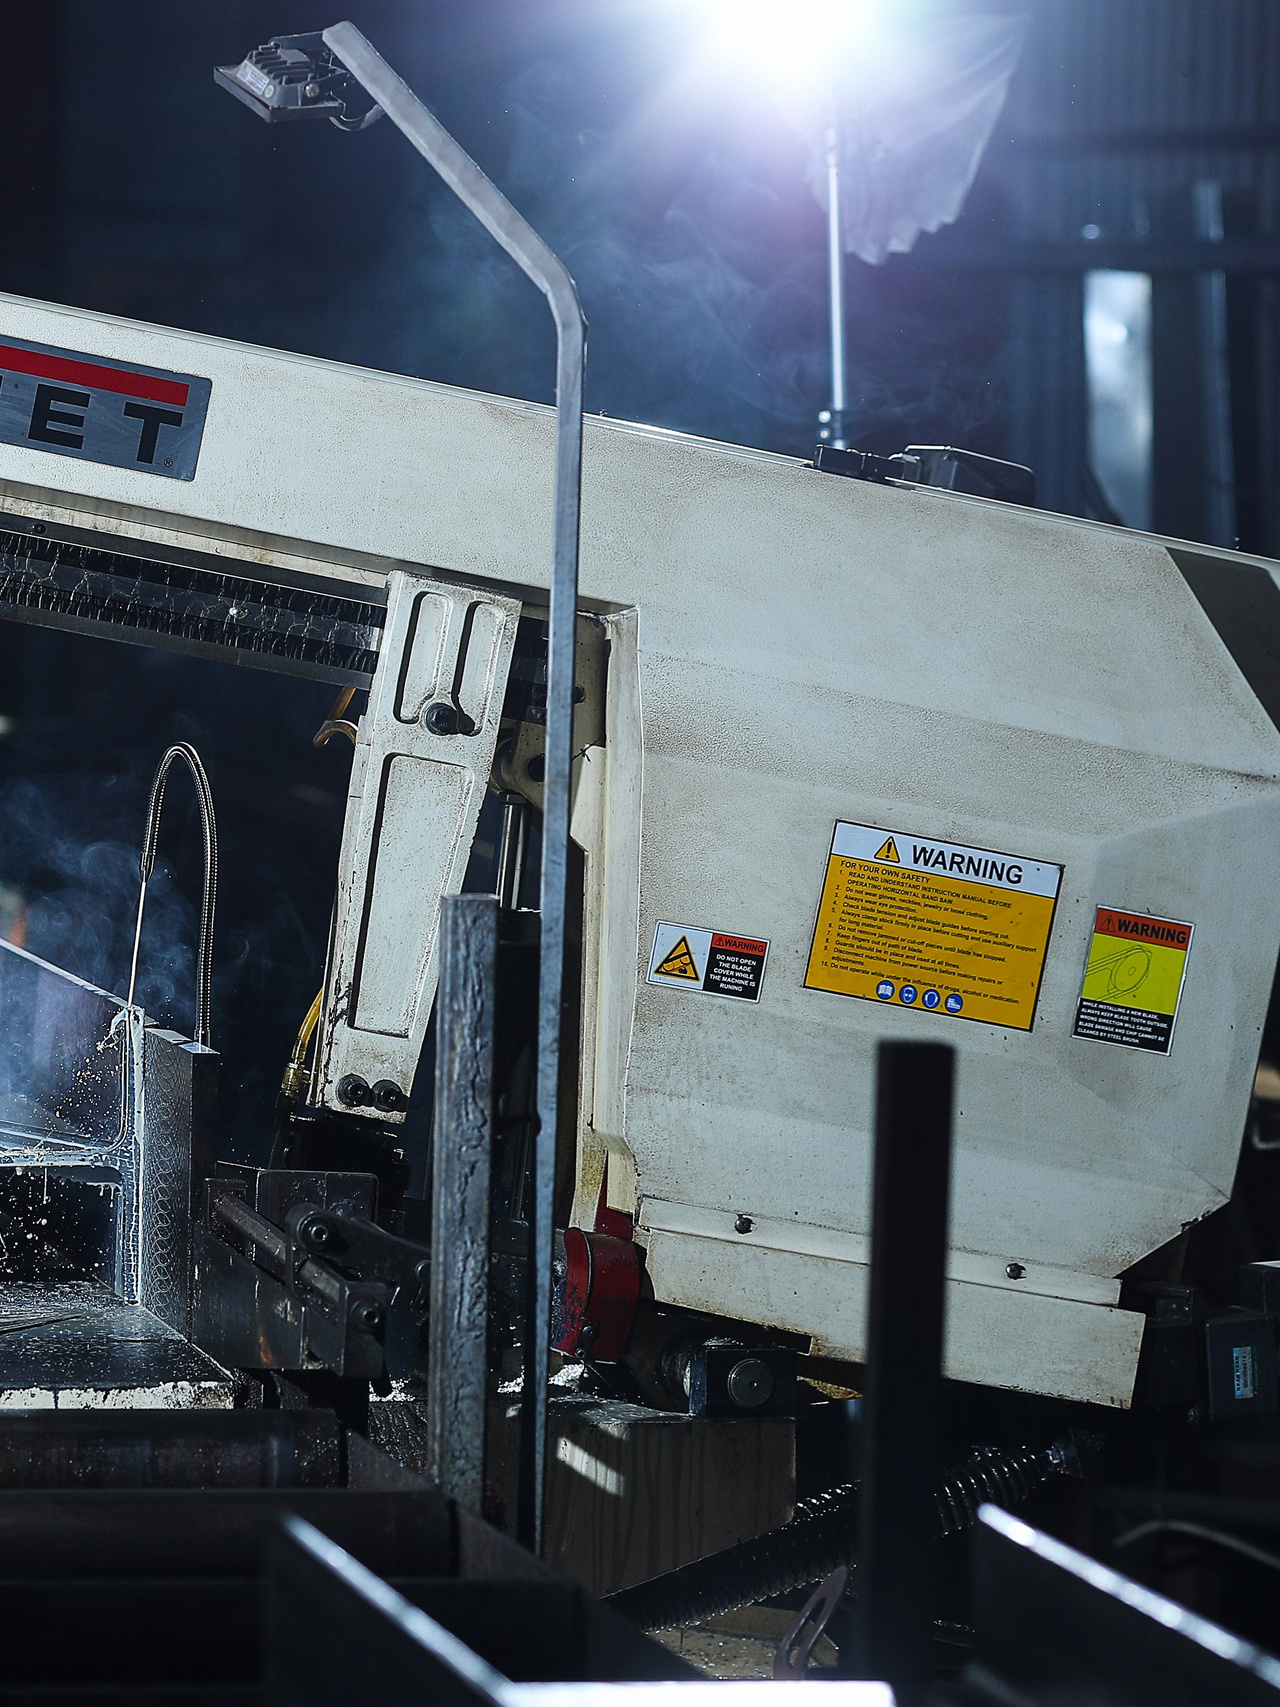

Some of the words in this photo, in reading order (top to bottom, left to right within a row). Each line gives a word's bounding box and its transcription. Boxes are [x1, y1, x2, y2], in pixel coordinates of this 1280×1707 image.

[910, 843, 1023, 885] WARNING
[840, 860, 856, 869] FOR
[857, 863, 879, 874] YOUR
[880, 868, 899, 877] OWN
[900, 872, 930, 884] SAFETY
[847, 878, 881, 890] OPERATING
[882, 885, 920, 898] HORIZONTAL
[921, 893, 938, 902] BAND
[939, 897, 954, 905] SAW.
[848, 871, 865, 879] READ
[866, 874, 879, 882] AND
[880, 877, 920, 890] UNDERSTAND
[921, 885, 960, 898] INSTRUCTION
[961, 893, 986, 903] MANUAL
[987, 898, 1011, 908] BEFORE
[1116, 917, 1187, 944] WARNING
[724, 938, 763, 952] WARNING
[731, 963, 751, 972] BLADE
[739, 958, 756, 966] OPEN
[709, 972, 721, 980] THE
[721, 975, 748, 986] MACHINE
[713, 966, 734, 976] COVER
[734, 971, 753, 980] WHILE
[719, 982, 742, 992] RUNING
[1081, 1007, 1100, 1015] ALWAYS
[1098, 1004, 1125, 1013] INSTALLING
[1098, 1017, 1123, 1026] DIRECTION
[1077, 1027, 1099, 1035] CLEANED
[1122, 1035, 1140, 1043] BRUSH.
[1137, 1031, 1157, 1039] CANNOT
